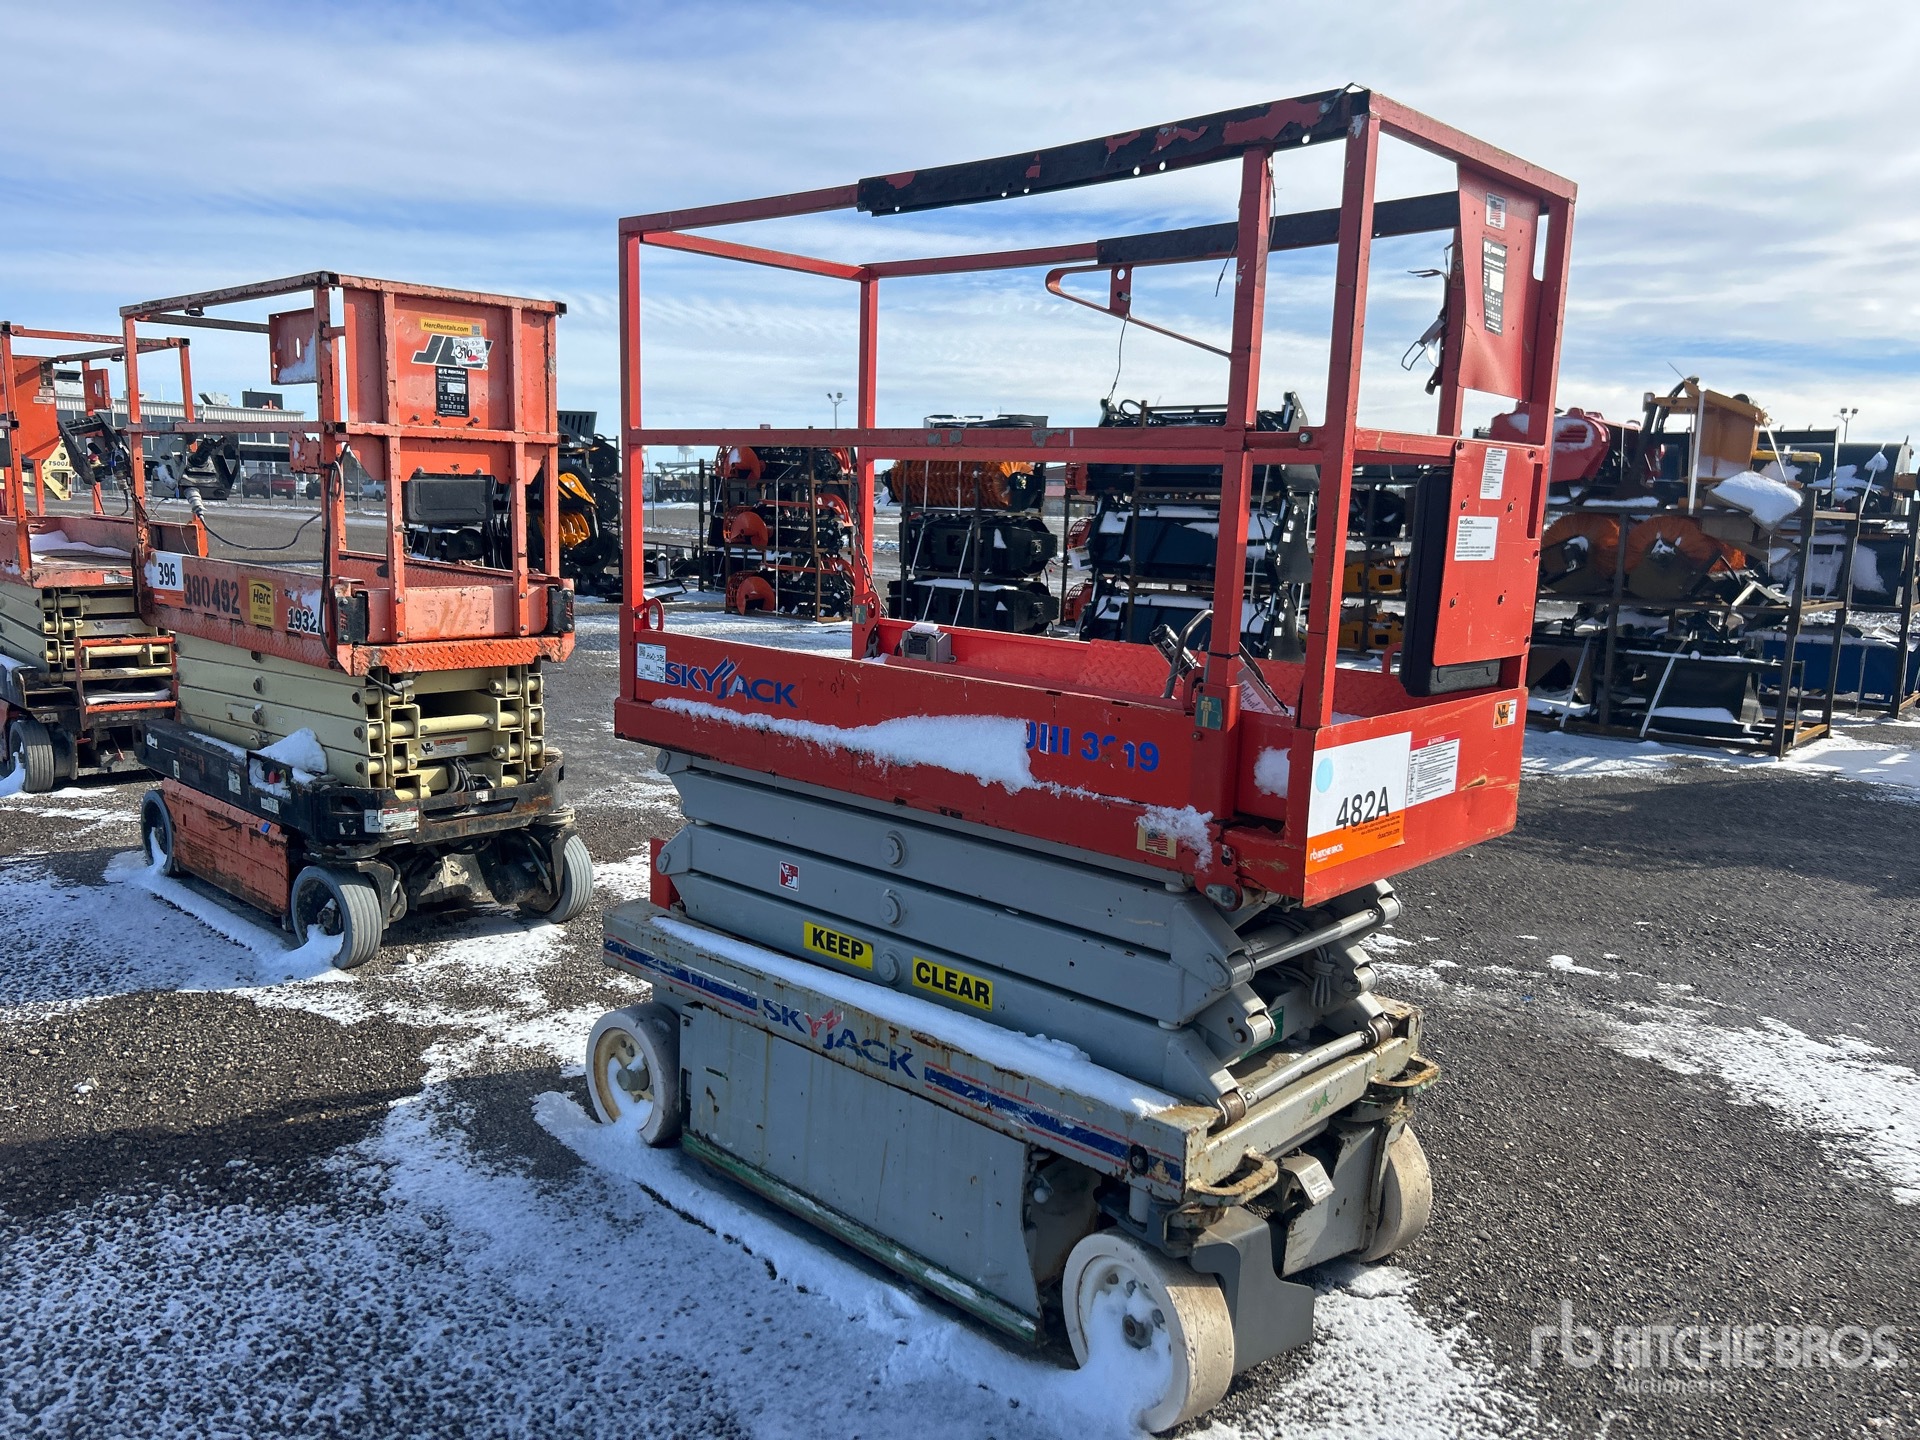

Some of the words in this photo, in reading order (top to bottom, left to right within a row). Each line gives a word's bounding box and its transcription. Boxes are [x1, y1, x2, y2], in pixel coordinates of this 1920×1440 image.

[423, 321, 469, 332] HercRentals.com
[158, 562, 177, 587] 396
[183, 572, 241, 615] 380492
[253, 588, 271, 606] Herc
[664, 656, 798, 709] SKYJACK
[1336, 786, 1389, 830] 482A
[812, 927, 864, 960] KEEP
[916, 962, 990, 1006] CLEAR
[762, 998, 918, 1080] SKYJACK
